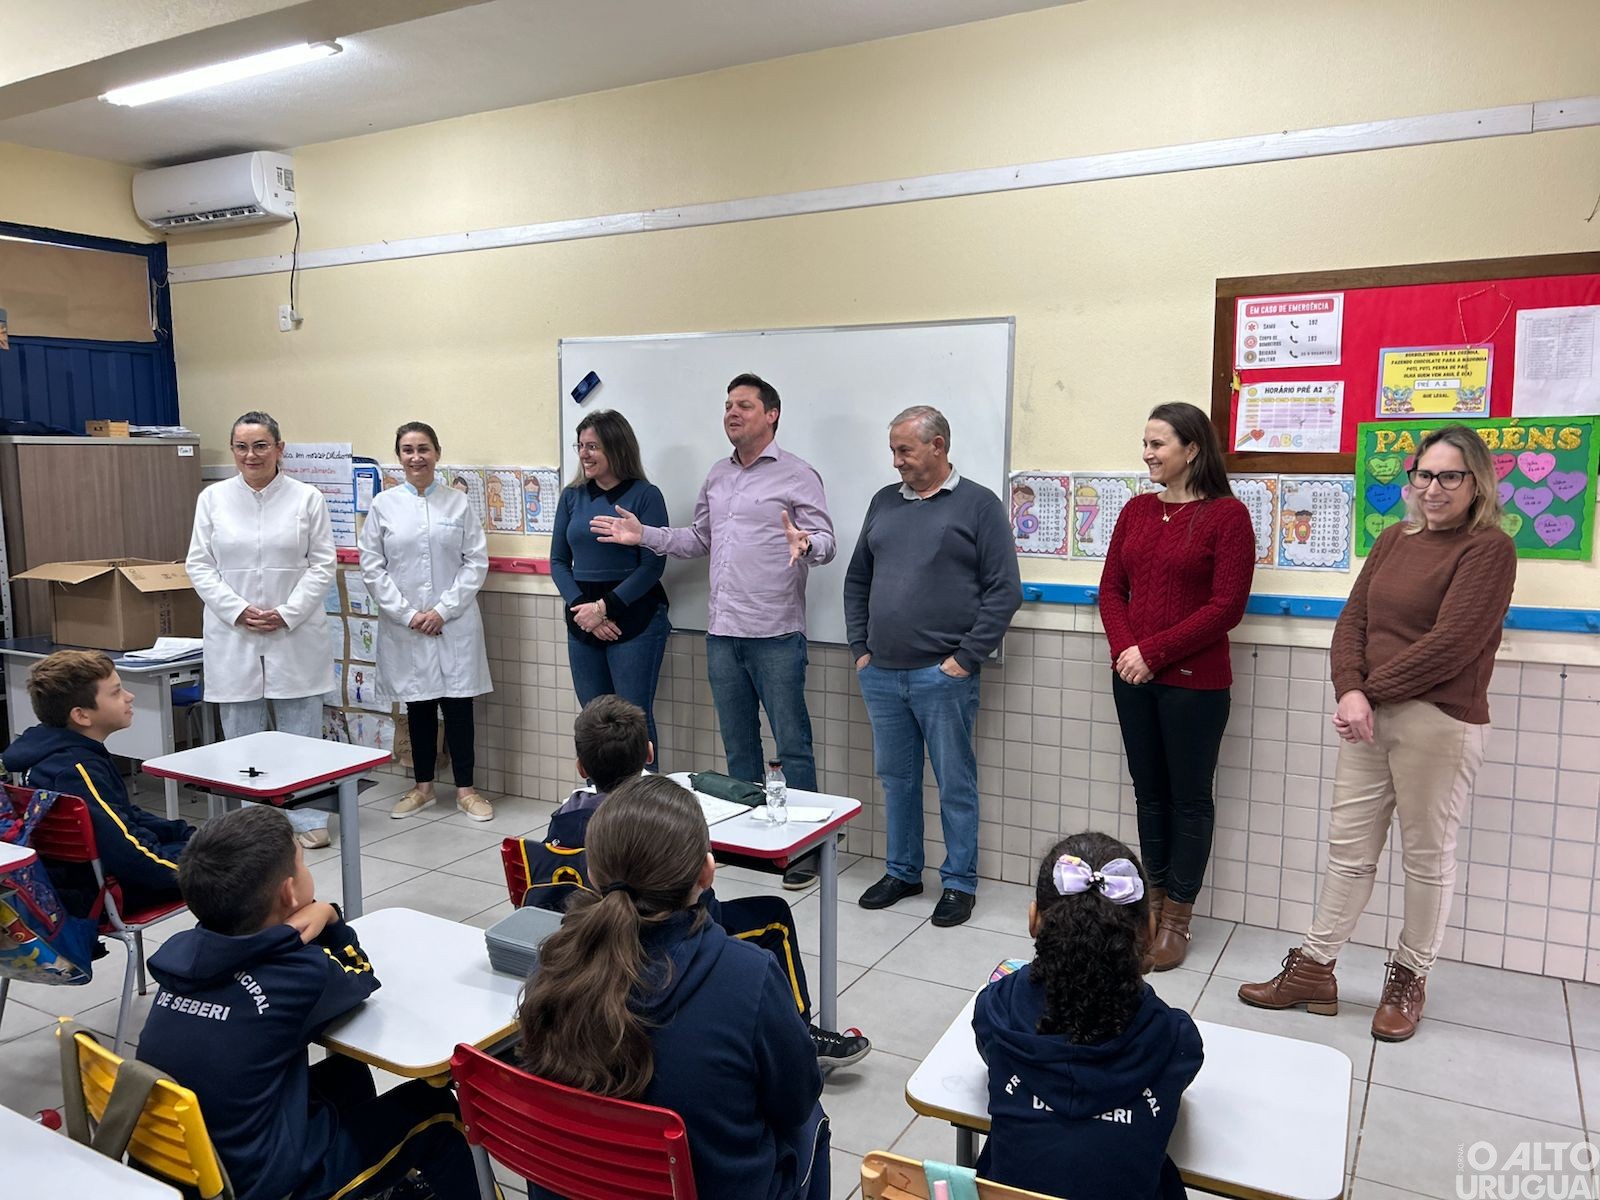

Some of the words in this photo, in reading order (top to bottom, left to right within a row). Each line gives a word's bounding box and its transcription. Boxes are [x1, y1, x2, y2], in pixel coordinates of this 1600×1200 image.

[1250, 306, 1260, 314] EM
[1261, 304, 1277, 314] CASO
[1279, 304, 1287, 313] DE
[1288, 302, 1329, 312] EMERGÊNCIA
[1264, 385, 1294, 394] HORÁRIO
[1296, 384, 1311, 393] PRÉ
[1375, 418, 1582, 453] PABÉNS
[525, 492, 541, 516] 5
[1017, 502, 1039, 534] 6
[1076, 505, 1100, 536] 7
[157, 992, 173, 1007] DE
[170, 996, 231, 1021] SEBERI
